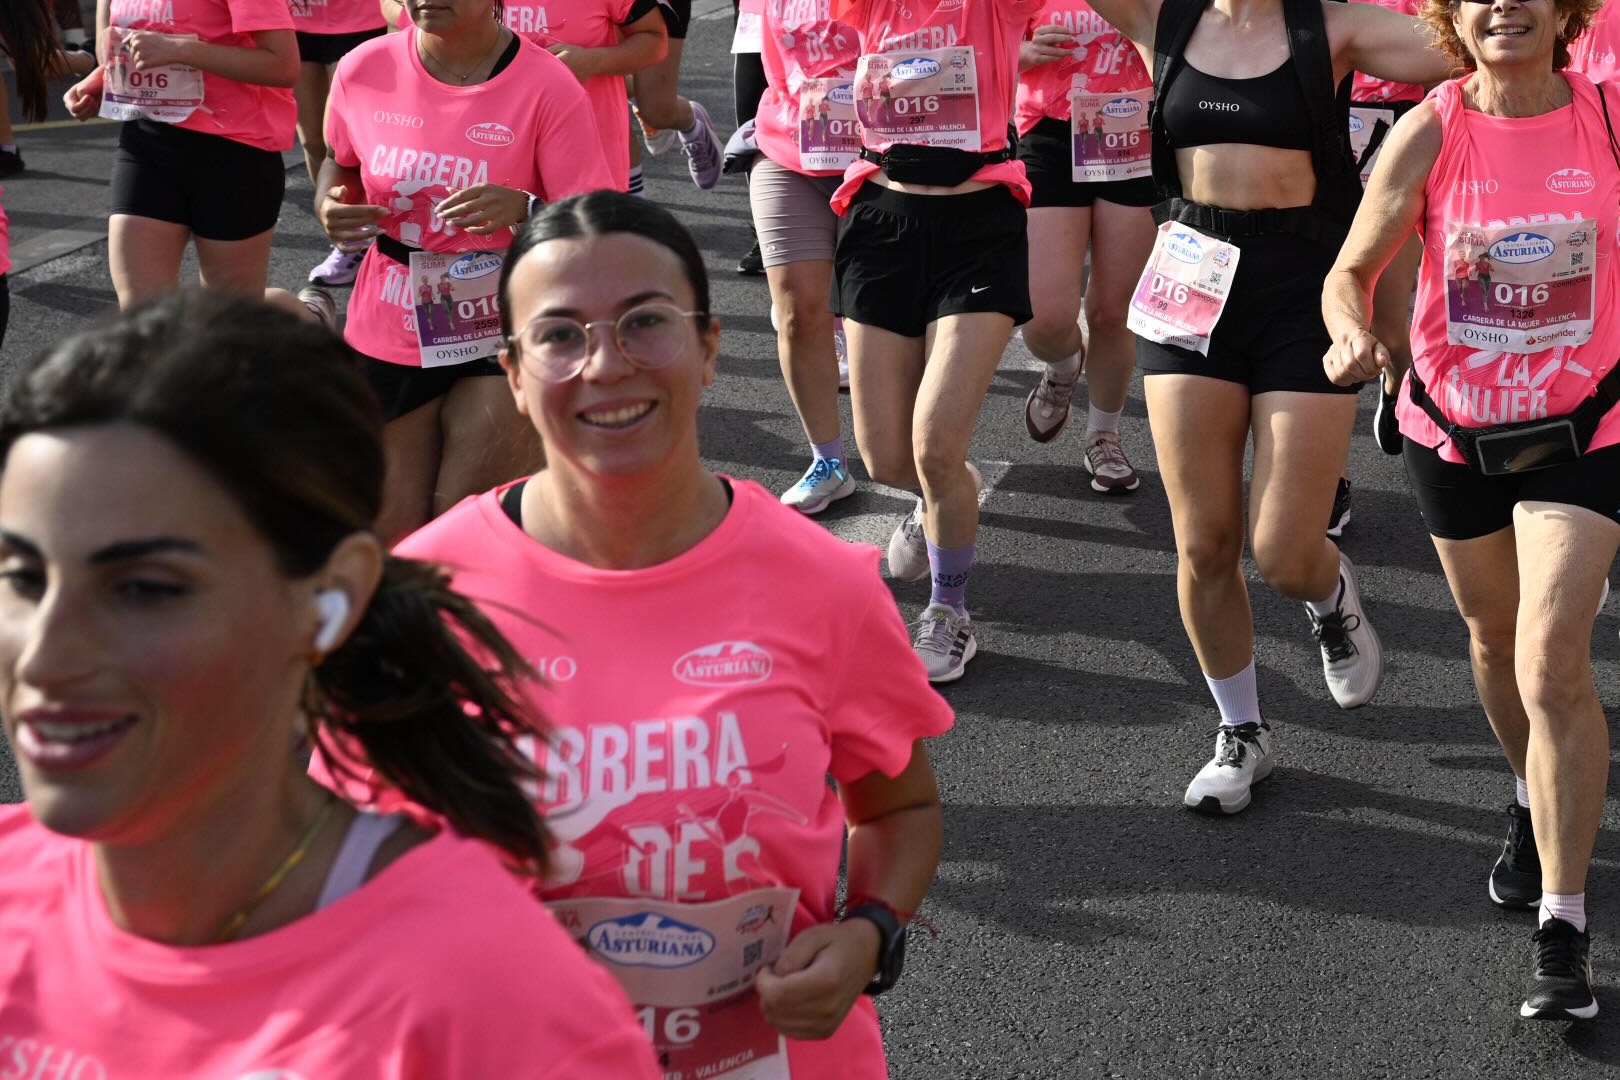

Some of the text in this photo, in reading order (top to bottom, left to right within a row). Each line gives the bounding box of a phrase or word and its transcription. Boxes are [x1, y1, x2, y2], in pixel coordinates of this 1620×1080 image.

[895, 66, 937, 75] ASTURIANA
[129, 71, 168, 88] 016
[831, 90, 853, 100] ASTUR
[894, 96, 940, 114] 016
[1104, 104, 1140, 114] ASTURIANA
[1198, 100, 1240, 112] OYSHO
[374, 110, 424, 129] OYSHO
[470, 128, 511, 143] ASTURIANA
[1105, 131, 1140, 148] 016
[369, 144, 490, 190] CARRERA
[809, 156, 838, 165] OYSHO
[1084, 167, 1116, 177] OYSHO
[1455, 179, 1498, 195] OYSHO
[1550, 179, 1593, 189] ASTURIANA
[1493, 245, 1551, 258] ASTURIANA
[452, 259, 501, 277] ASTURIANA
[1150, 273, 1190, 305] 016
[1494, 283, 1550, 306] 016
[1157, 300, 1168, 311] 99
[1510, 308, 1535, 319] 1326
[1462, 314, 1494, 325] CARRERA
[1518, 319, 1540, 329] MUJER
[1546, 311, 1577, 324] VALENCIA
[433, 335, 462, 345] CARRERA
[464, 333, 474, 341] DE
[484, 328, 502, 337] MUJE
[1160, 329, 1198, 348] Santander
[1464, 328, 1509, 345] OYSHO
[1537, 329, 1577, 344] Santander
[436, 345, 479, 359] OYSHO
[1496, 353, 1531, 387] LA
[1447, 383, 1549, 425] MUJER
[684, 659, 766, 678] ASTURIANA
[515, 711, 752, 804] ARRERA
[597, 928, 705, 957] ASTURIANA
[636, 1007, 700, 1044] 16
[0, 1035, 108, 1080] SHO
[696, 1049, 754, 1080] VALENCIA
